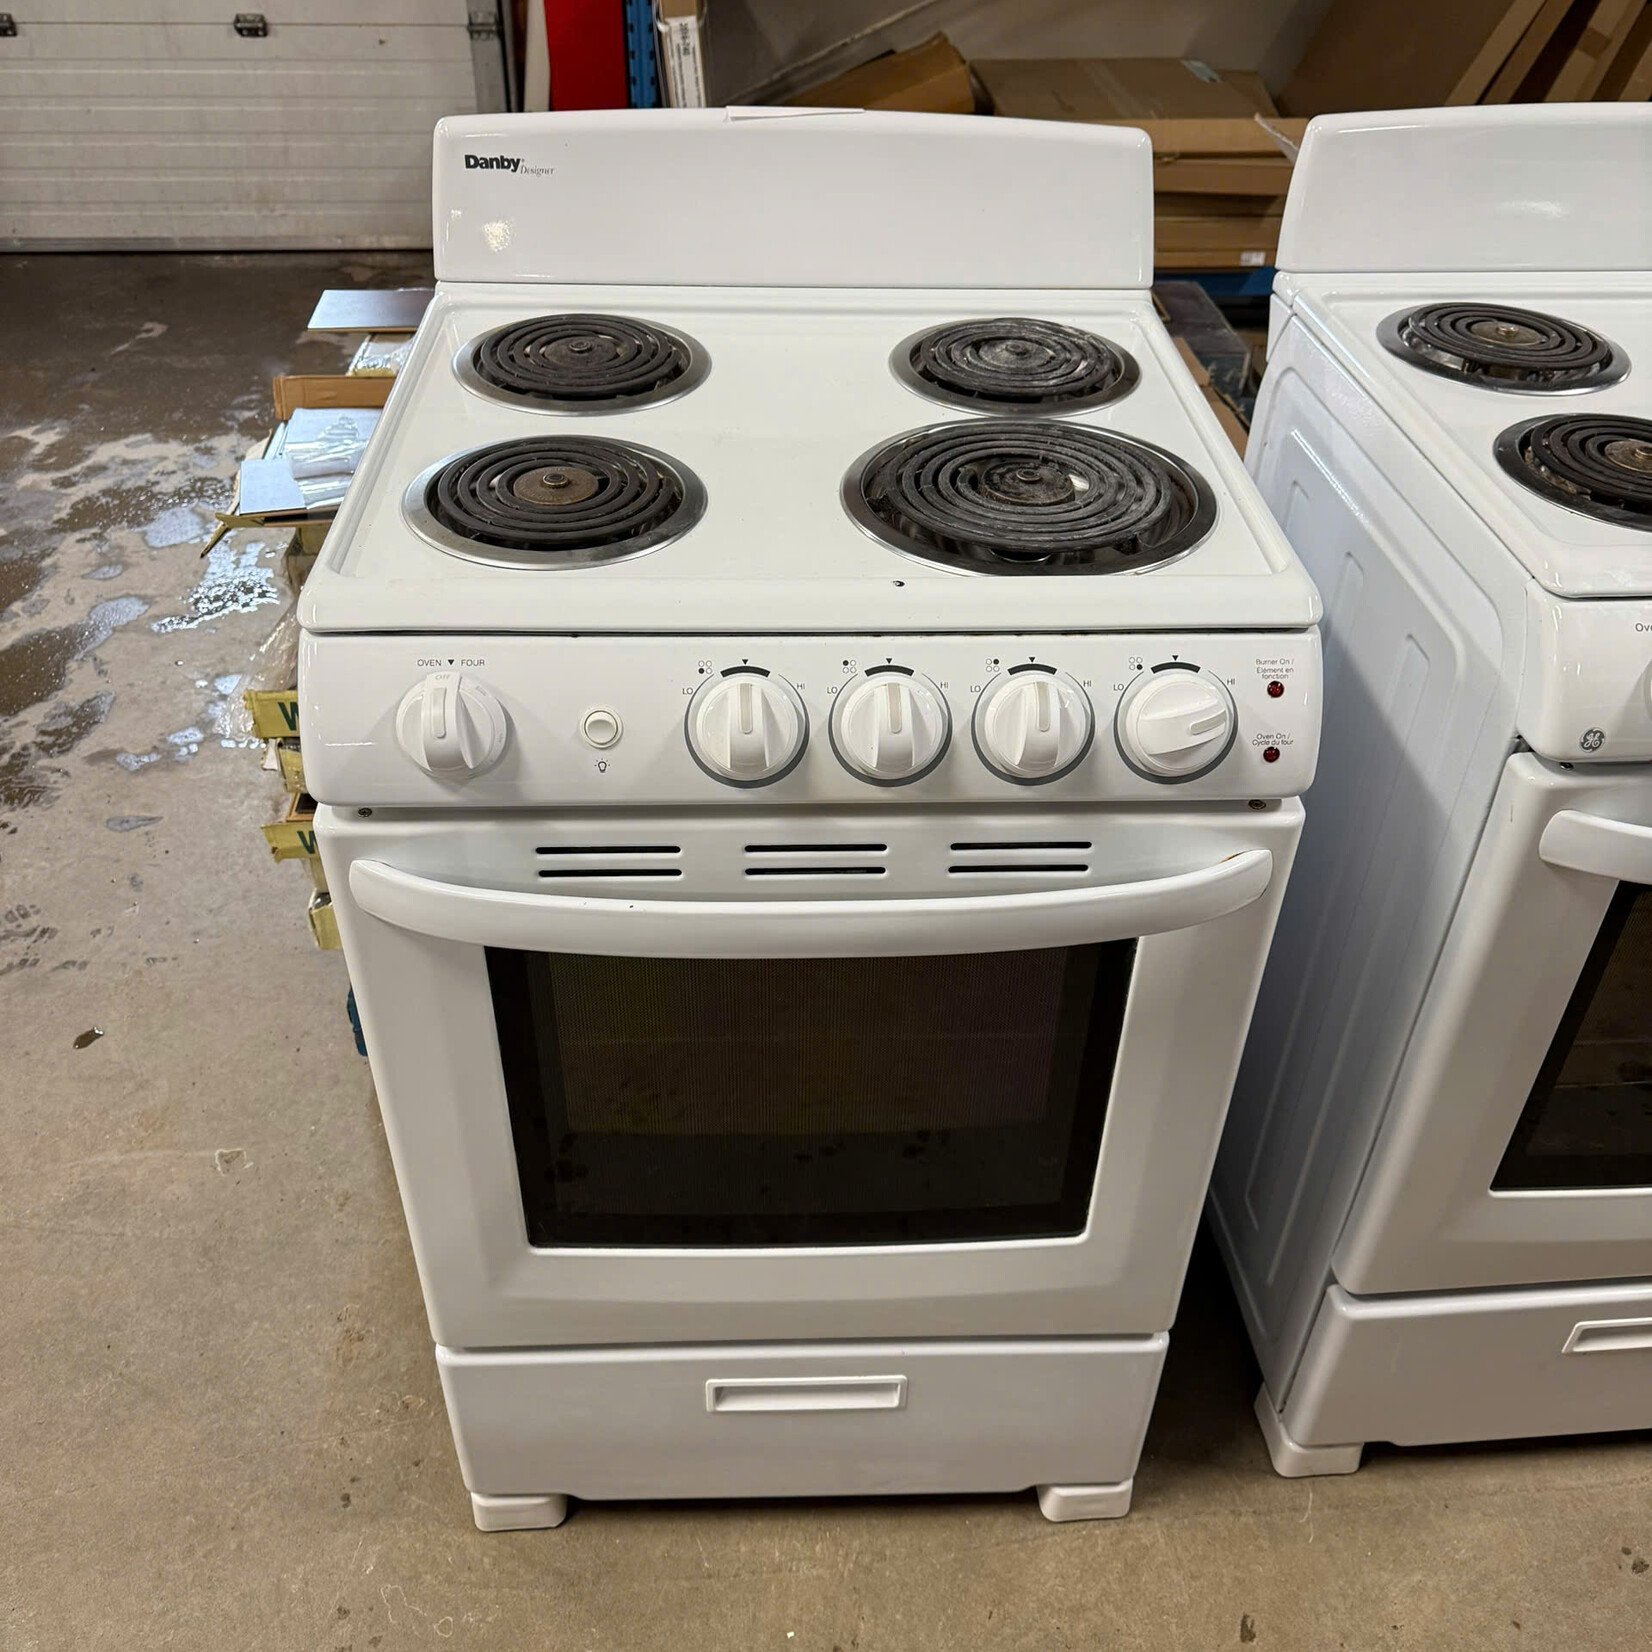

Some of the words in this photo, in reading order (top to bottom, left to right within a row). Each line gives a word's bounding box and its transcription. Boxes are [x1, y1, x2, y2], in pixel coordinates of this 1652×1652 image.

[464, 154, 521, 173] Danby
[520, 165, 556, 177] Designer
[417, 658, 442, 667] OVEN
[460, 658, 485, 667] FOUR
[1255, 658, 1278, 666] Burner
[940, 681, 949, 690] HI
[1083, 680, 1092, 688] HI
[1226, 678, 1236, 686] HI
[682, 686, 694, 696] LO
[796, 683, 806, 691] HI
[826, 686, 838, 695] LO
[970, 684, 981, 693] LO
[1113, 683, 1124, 692] LO
[1252, 739, 1270, 747] Cycle
